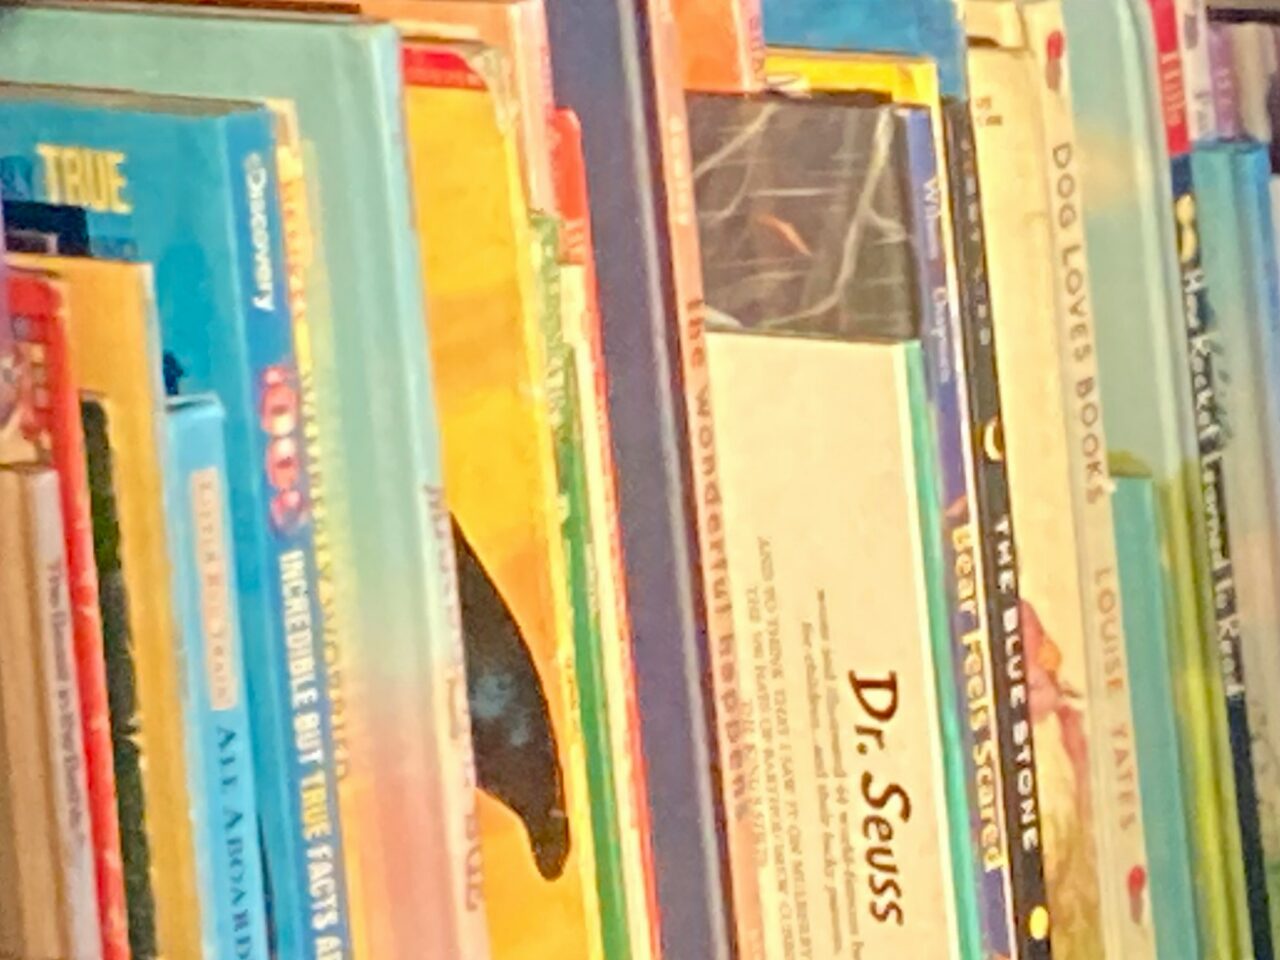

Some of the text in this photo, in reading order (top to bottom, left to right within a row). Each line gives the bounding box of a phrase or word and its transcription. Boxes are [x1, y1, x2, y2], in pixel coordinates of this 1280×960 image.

[36, 143, 132, 213] TRUE
[685, 298, 708, 369] the
[1051, 142, 1107, 505] DOG LOVES BOOKS
[692, 384, 731, 614] wonderful
[1182, 267, 1208, 329] How
[1216, 614, 1246, 698] Read
[278, 550, 318, 709] INCREDIBLE
[291, 712, 324, 764] BUT
[950, 522, 1004, 871] Bear Feels Scared
[993, 514, 1039, 853] THE BLUE STONE
[1094, 567, 1137, 831] LOUISE YATES
[297, 770, 333, 839] TRUE
[304, 845, 339, 929] FACTS
[848, 669, 915, 925] Dr. Seuss
